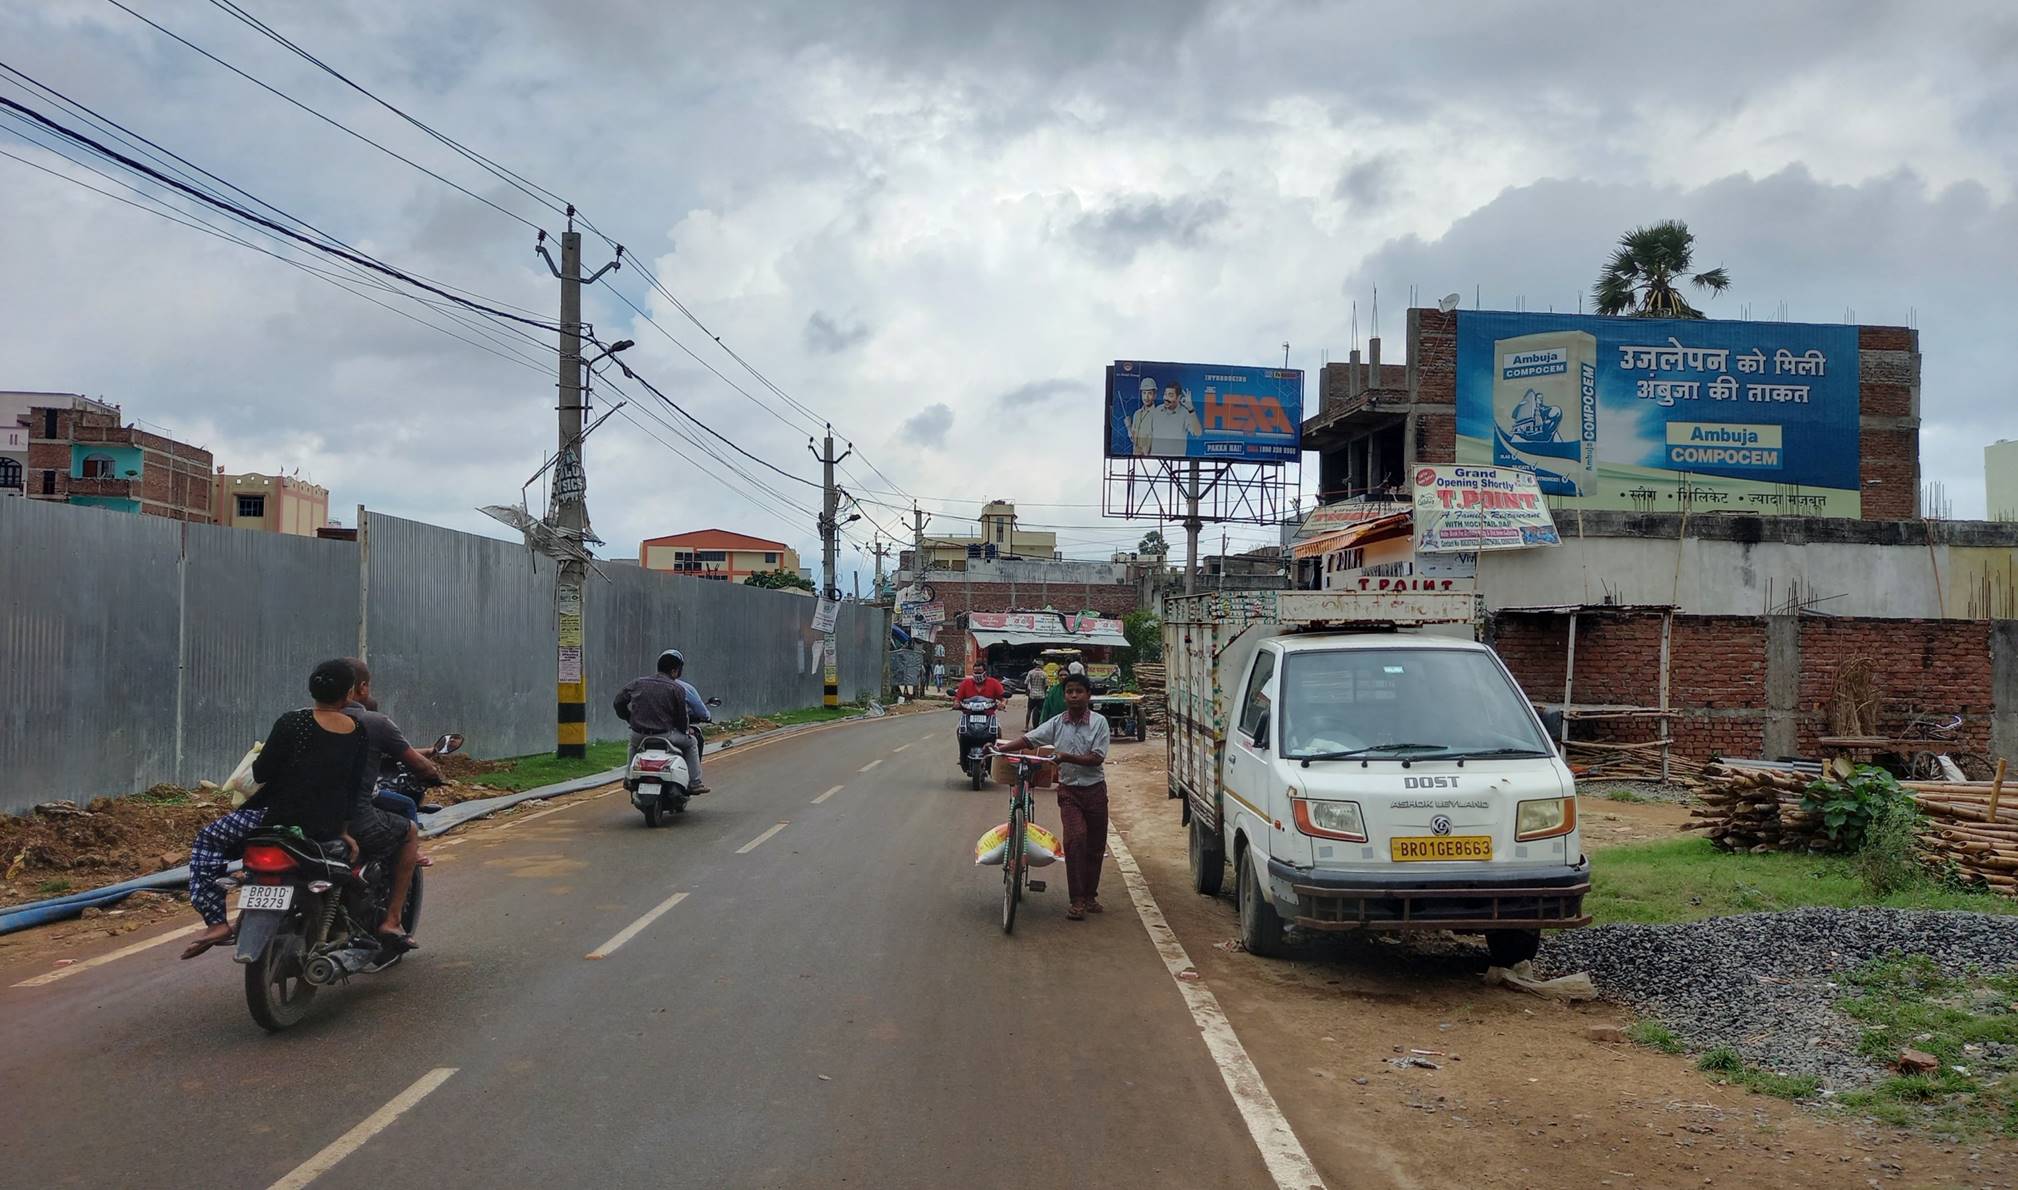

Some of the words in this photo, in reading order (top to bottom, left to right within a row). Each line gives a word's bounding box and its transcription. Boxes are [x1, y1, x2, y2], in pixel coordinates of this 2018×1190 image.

[1513, 352, 1558, 365] Ambuja
[1619, 337, 1730, 372] उजलेपन
[1736, 348, 1767, 375] को
[1773, 349, 1826, 376] मिली
[1506, 364, 1564, 377] COMPOCEM
[1636, 373, 1700, 406] अंबुजा
[1707, 376, 1739, 401] की
[1746, 384, 1810, 403] ताकत
[1583, 366, 1594, 440] COMPOCEM
[1204, 392, 1294, 434] HEXA
[1690, 426, 1758, 445] Ambuja
[1671, 447, 1778, 465] COMPOCEM
[1454, 468, 1496, 478] Grand
[1436, 478, 1478, 488] Opening
[1480, 478, 1514, 492] Shortly
[1436, 490, 1540, 510] T.POINT
[1404, 776, 1460, 789] DOST
[1400, 841, 1490, 857] BR01GE8663
[250, 886, 286, 897] BR01D
[246, 898, 284, 908] E3279
